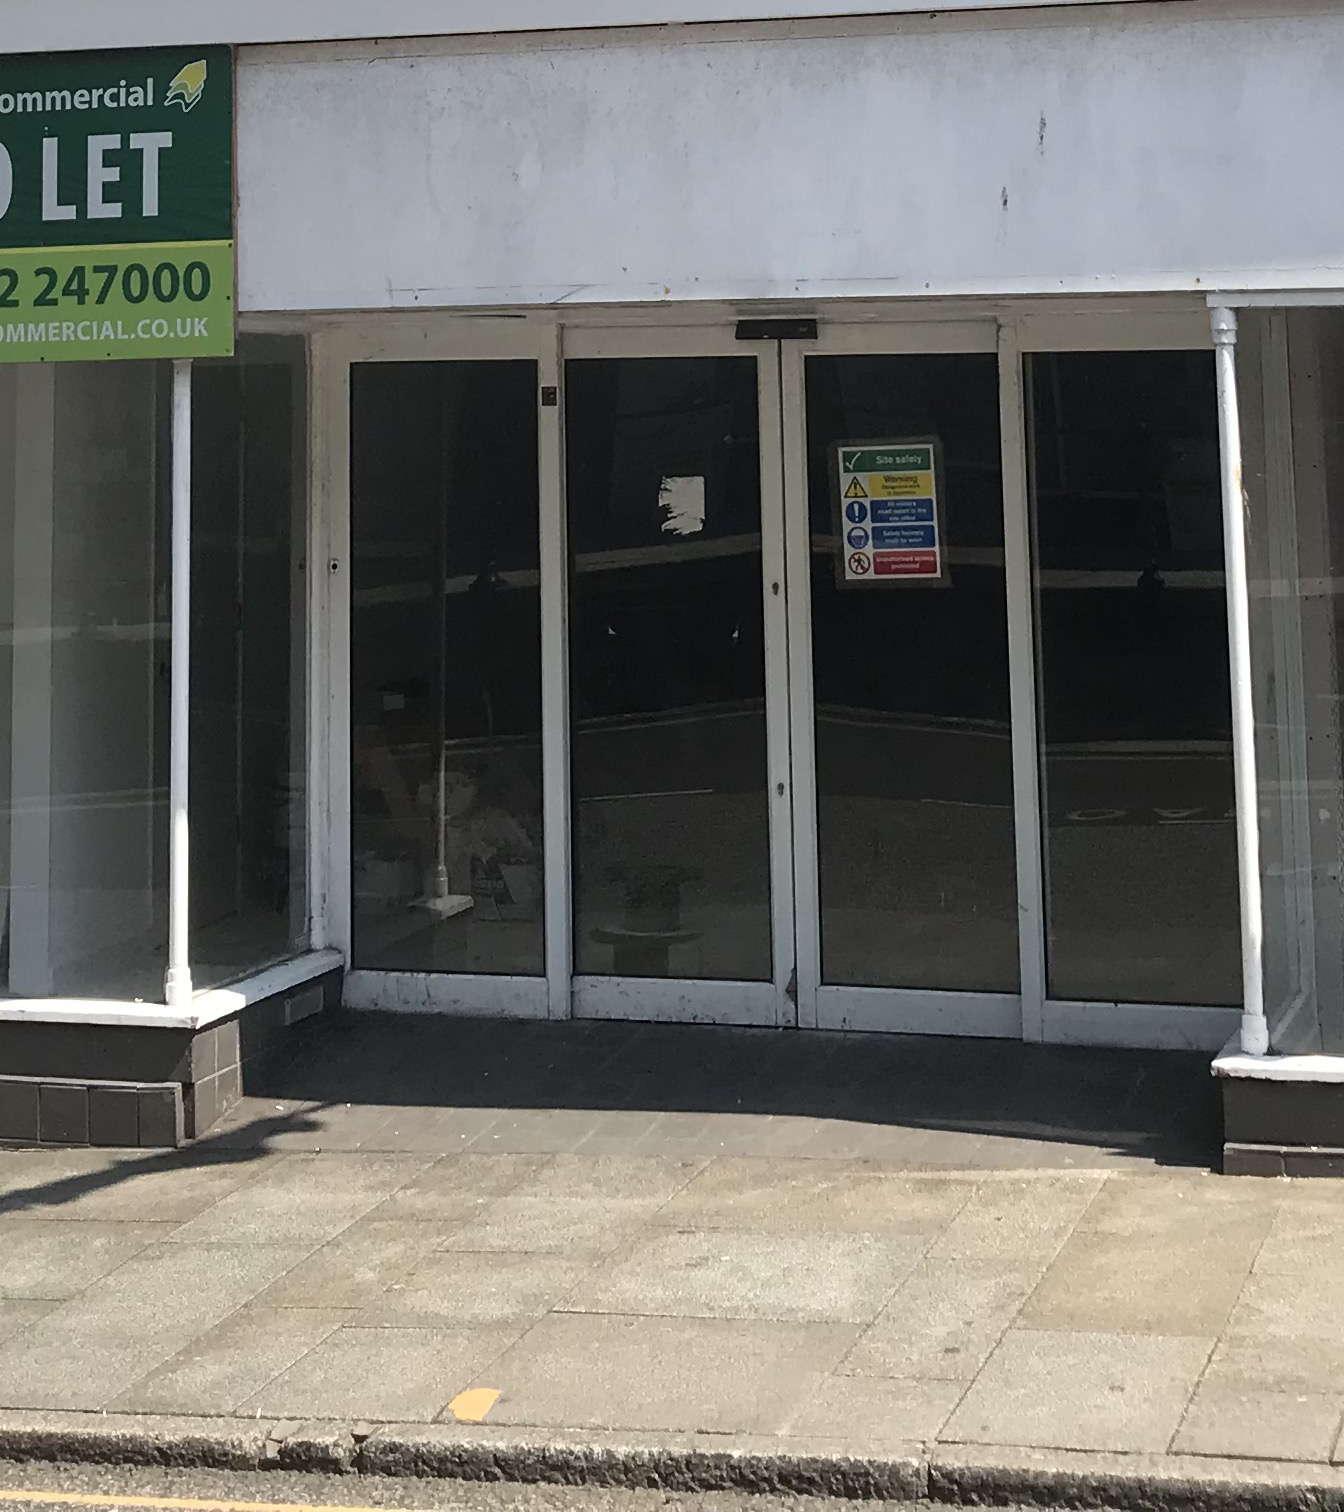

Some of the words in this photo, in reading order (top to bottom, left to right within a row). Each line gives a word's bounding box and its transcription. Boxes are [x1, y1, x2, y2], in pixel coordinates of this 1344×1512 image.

[42, 131, 173, 221] LET
[33, 261, 211, 308] 247000
[876, 455, 893, 465] Site
[895, 454, 922, 465] safety
